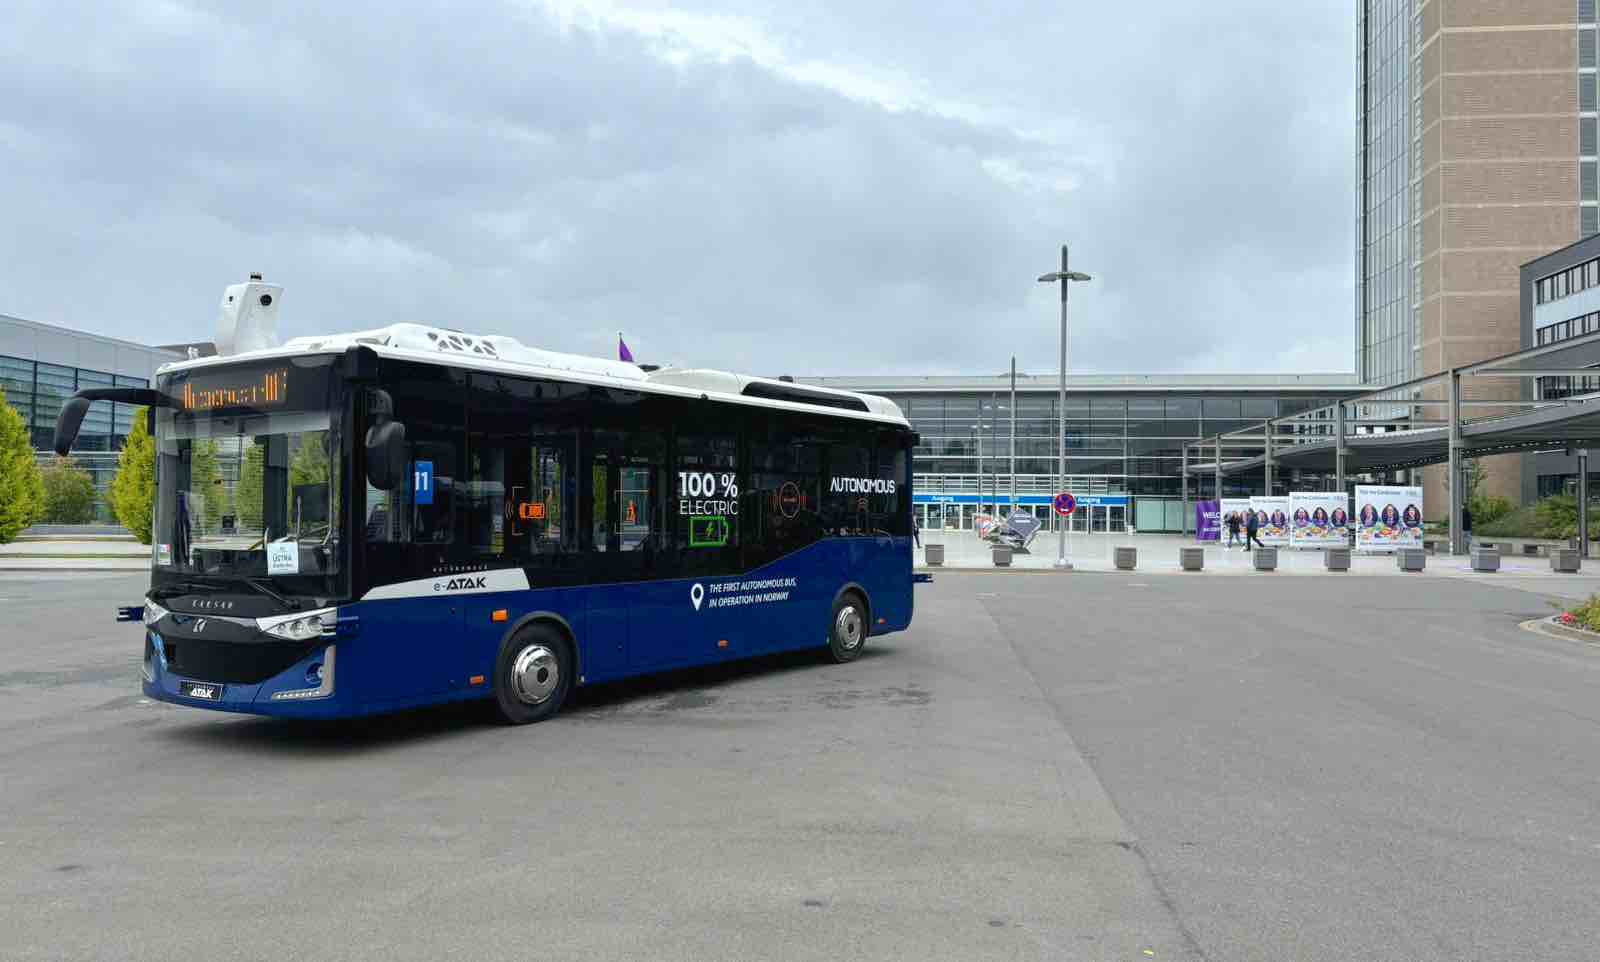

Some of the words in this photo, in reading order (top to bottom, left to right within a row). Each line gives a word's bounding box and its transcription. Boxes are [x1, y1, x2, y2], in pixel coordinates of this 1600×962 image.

[678, 472, 715, 497] 100
[721, 473, 738, 497] %
[830, 477, 896, 494] AUTONOMOUS
[679, 500, 738, 515] ELECTRIC
[1202, 511, 1221, 519] WELC
[433, 576, 487, 592] e-ATAK
[709, 583, 722, 593] THE
[722, 582, 741, 592] FIRST
[740, 579, 785, 591] AUTONOMOUS
[708, 598, 718, 608] IN
[718, 595, 754, 607] OPERATION
[754, 593, 763, 603] IN
[762, 591, 790, 602] NORWAY
[191, 687, 214, 698] ATAK
